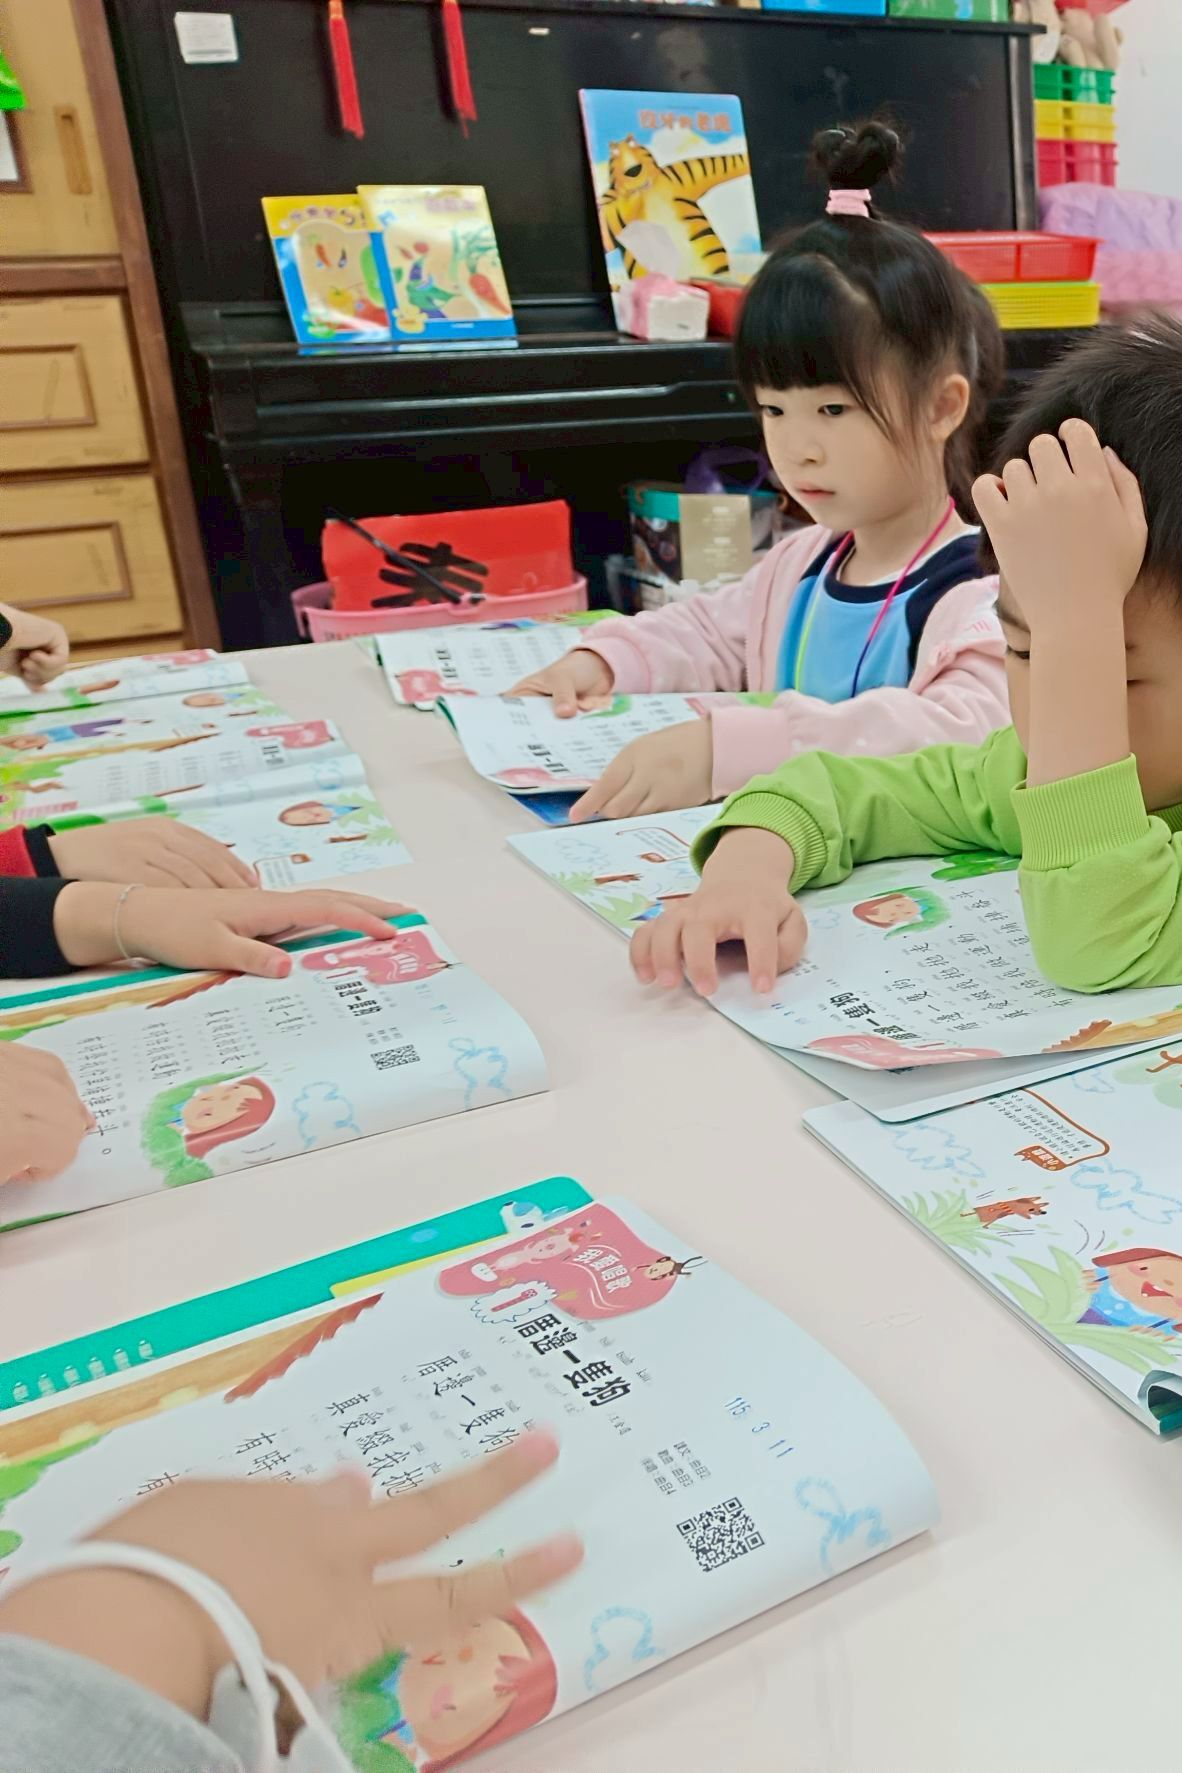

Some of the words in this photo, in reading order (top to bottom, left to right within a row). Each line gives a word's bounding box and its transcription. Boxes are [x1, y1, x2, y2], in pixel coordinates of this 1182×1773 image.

[573, 1248, 632, 1293] 我愛唱歌
[514, 1312, 631, 1407] 厝邊一隻狗
[417, 1355, 520, 1453] 厝邊一隻狗
[724, 1397, 751, 1416] 115
[752, 1421, 771, 1433] 3
[769, 1439, 794, 1459] 11
